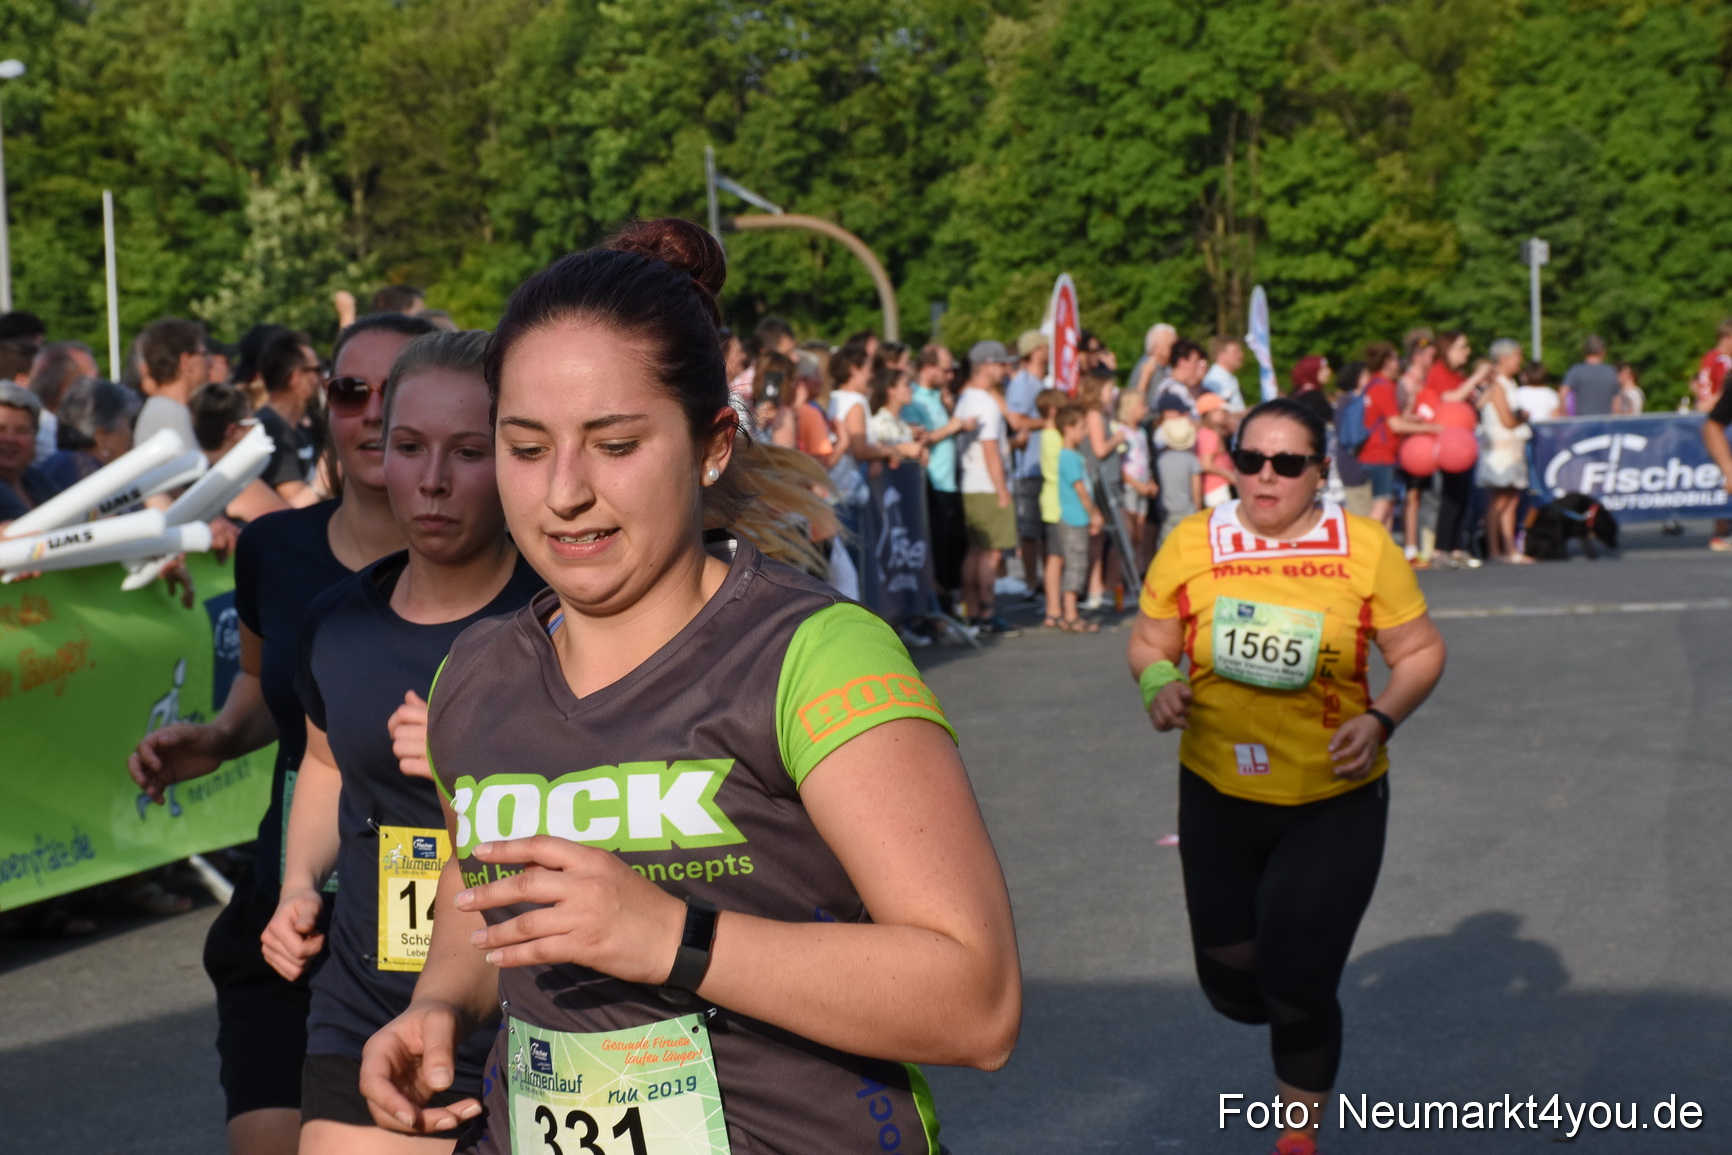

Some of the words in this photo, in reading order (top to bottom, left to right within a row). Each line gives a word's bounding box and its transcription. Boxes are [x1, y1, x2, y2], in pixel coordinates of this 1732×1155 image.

[1579, 457, 1727, 494] Fische
[1212, 564, 1272, 579] MAX
[1283, 561, 1350, 578] BÖGL
[1225, 628, 1303, 667] 1565
[402, 856, 447, 872] firmenl
[602, 1036, 649, 1050] Gesunde
[653, 1035, 690, 1048] Firmen
[624, 1052, 658, 1066] laufen
[662, 1048, 702, 1067] länger!
[648, 1076, 697, 1100] 2019
[534, 1104, 648, 1155] 331
